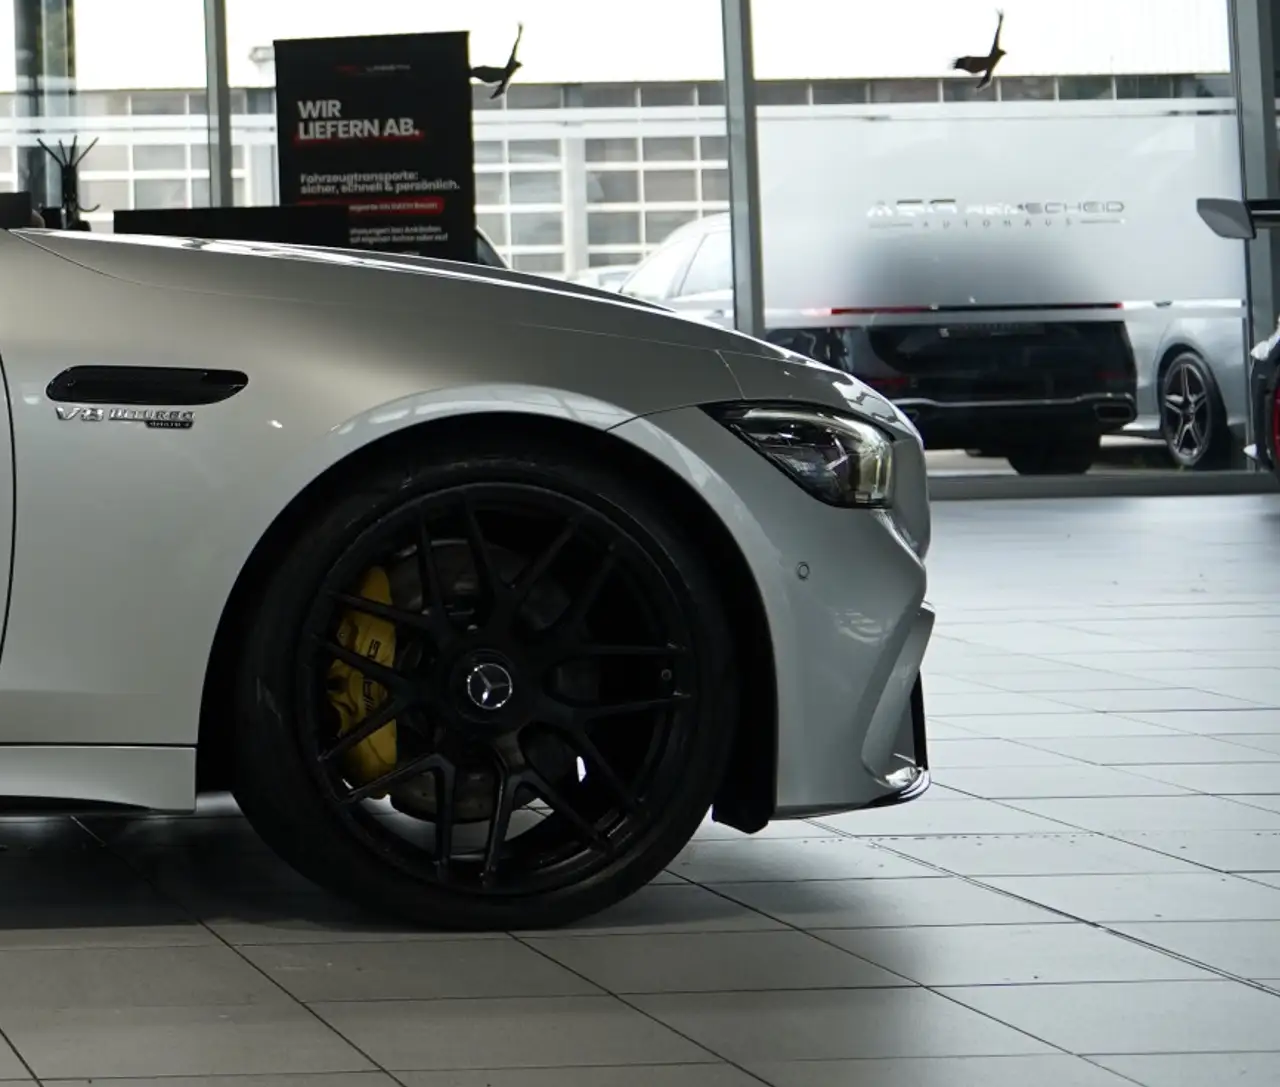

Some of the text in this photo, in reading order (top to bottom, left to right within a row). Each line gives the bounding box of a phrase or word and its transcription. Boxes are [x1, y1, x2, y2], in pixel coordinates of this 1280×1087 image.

[298, 100, 341, 118] WIR
[299, 118, 420, 140] LIEFERN AB.
[300, 171, 418, 185] Fahrzeugtransporte:
[300, 179, 461, 196] sicher, schnell & persönlich.
[56, 406, 104, 421] V8
